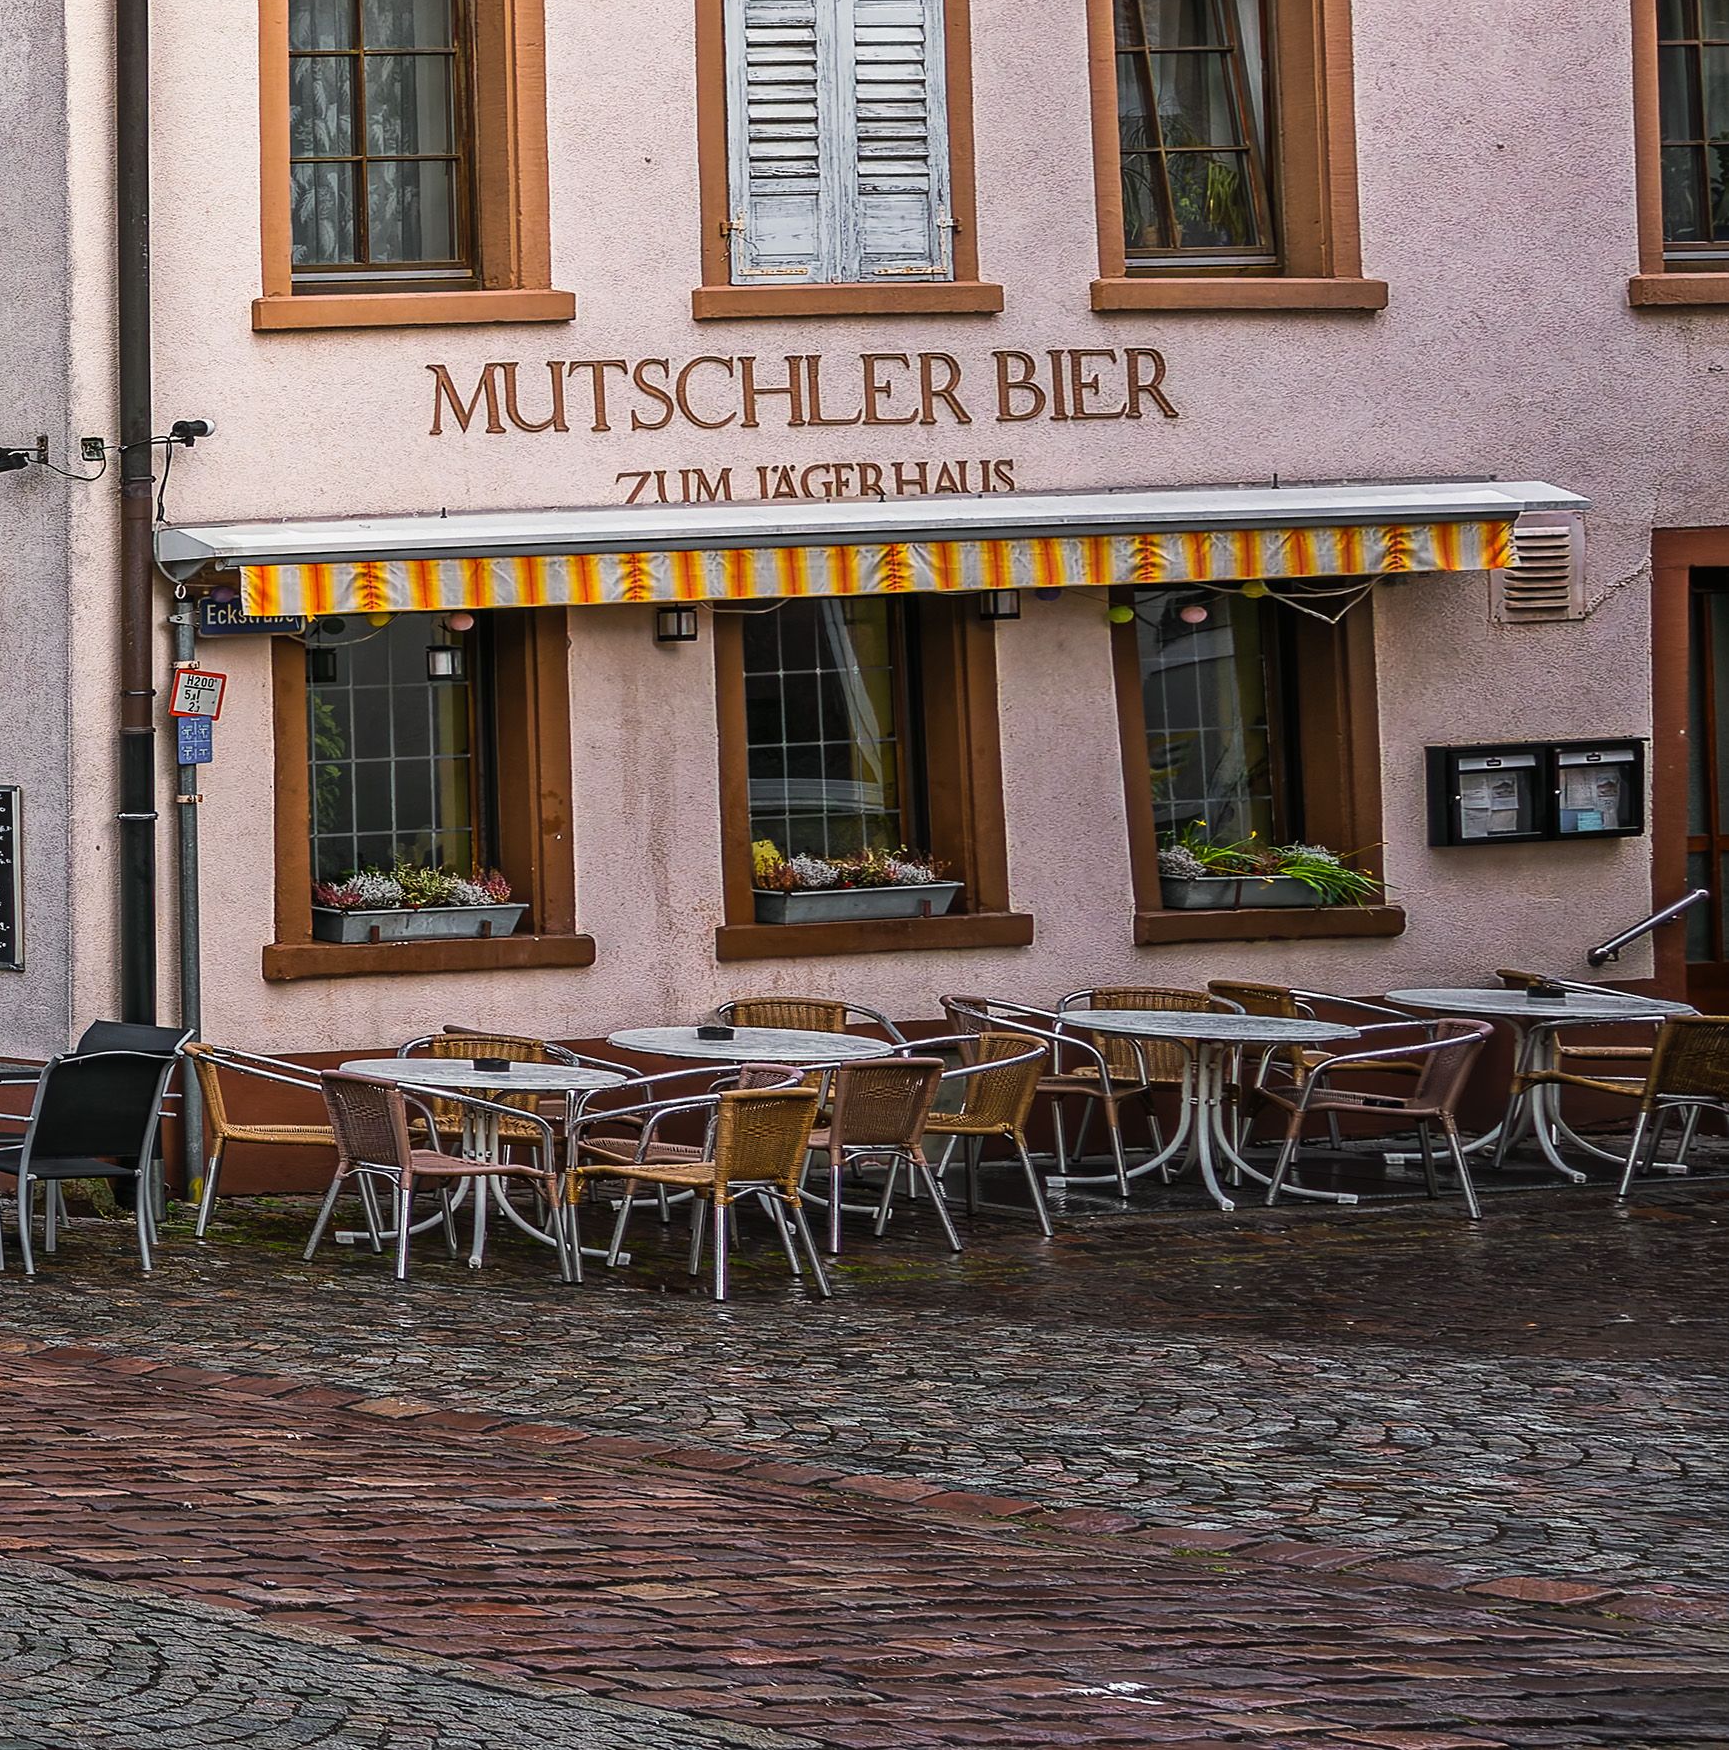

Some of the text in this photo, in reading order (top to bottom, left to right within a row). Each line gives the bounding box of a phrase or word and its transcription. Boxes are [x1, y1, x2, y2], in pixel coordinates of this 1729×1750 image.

[426, 347, 1180, 436] MUTSCHLER BIER
[614, 467, 734, 505] ZUM
